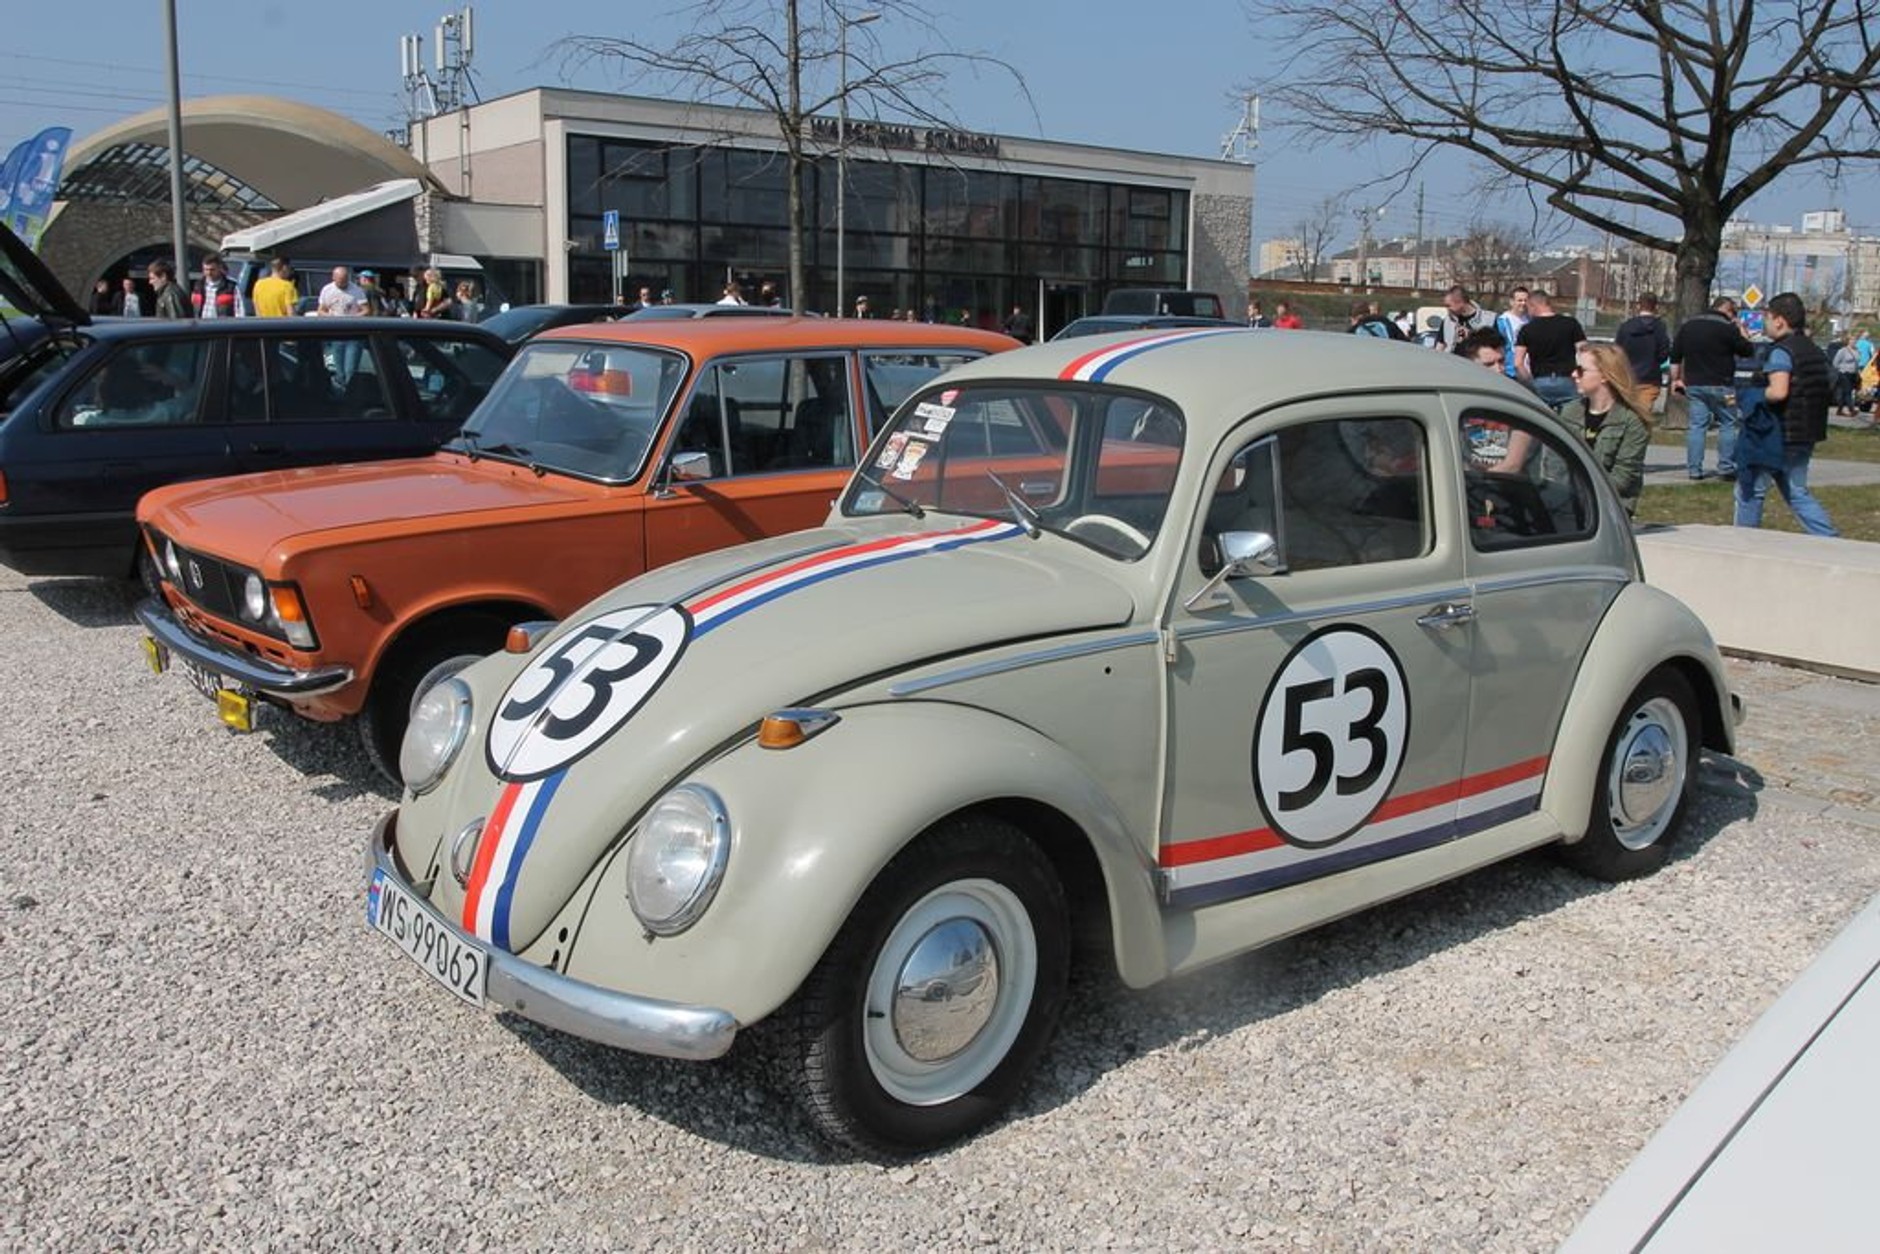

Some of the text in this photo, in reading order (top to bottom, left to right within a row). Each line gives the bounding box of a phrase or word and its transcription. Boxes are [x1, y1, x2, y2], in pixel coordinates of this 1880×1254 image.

[501, 624, 664, 741] 53
[1278, 667, 1390, 812] 53
[380, 884, 478, 1000] WS 99062
